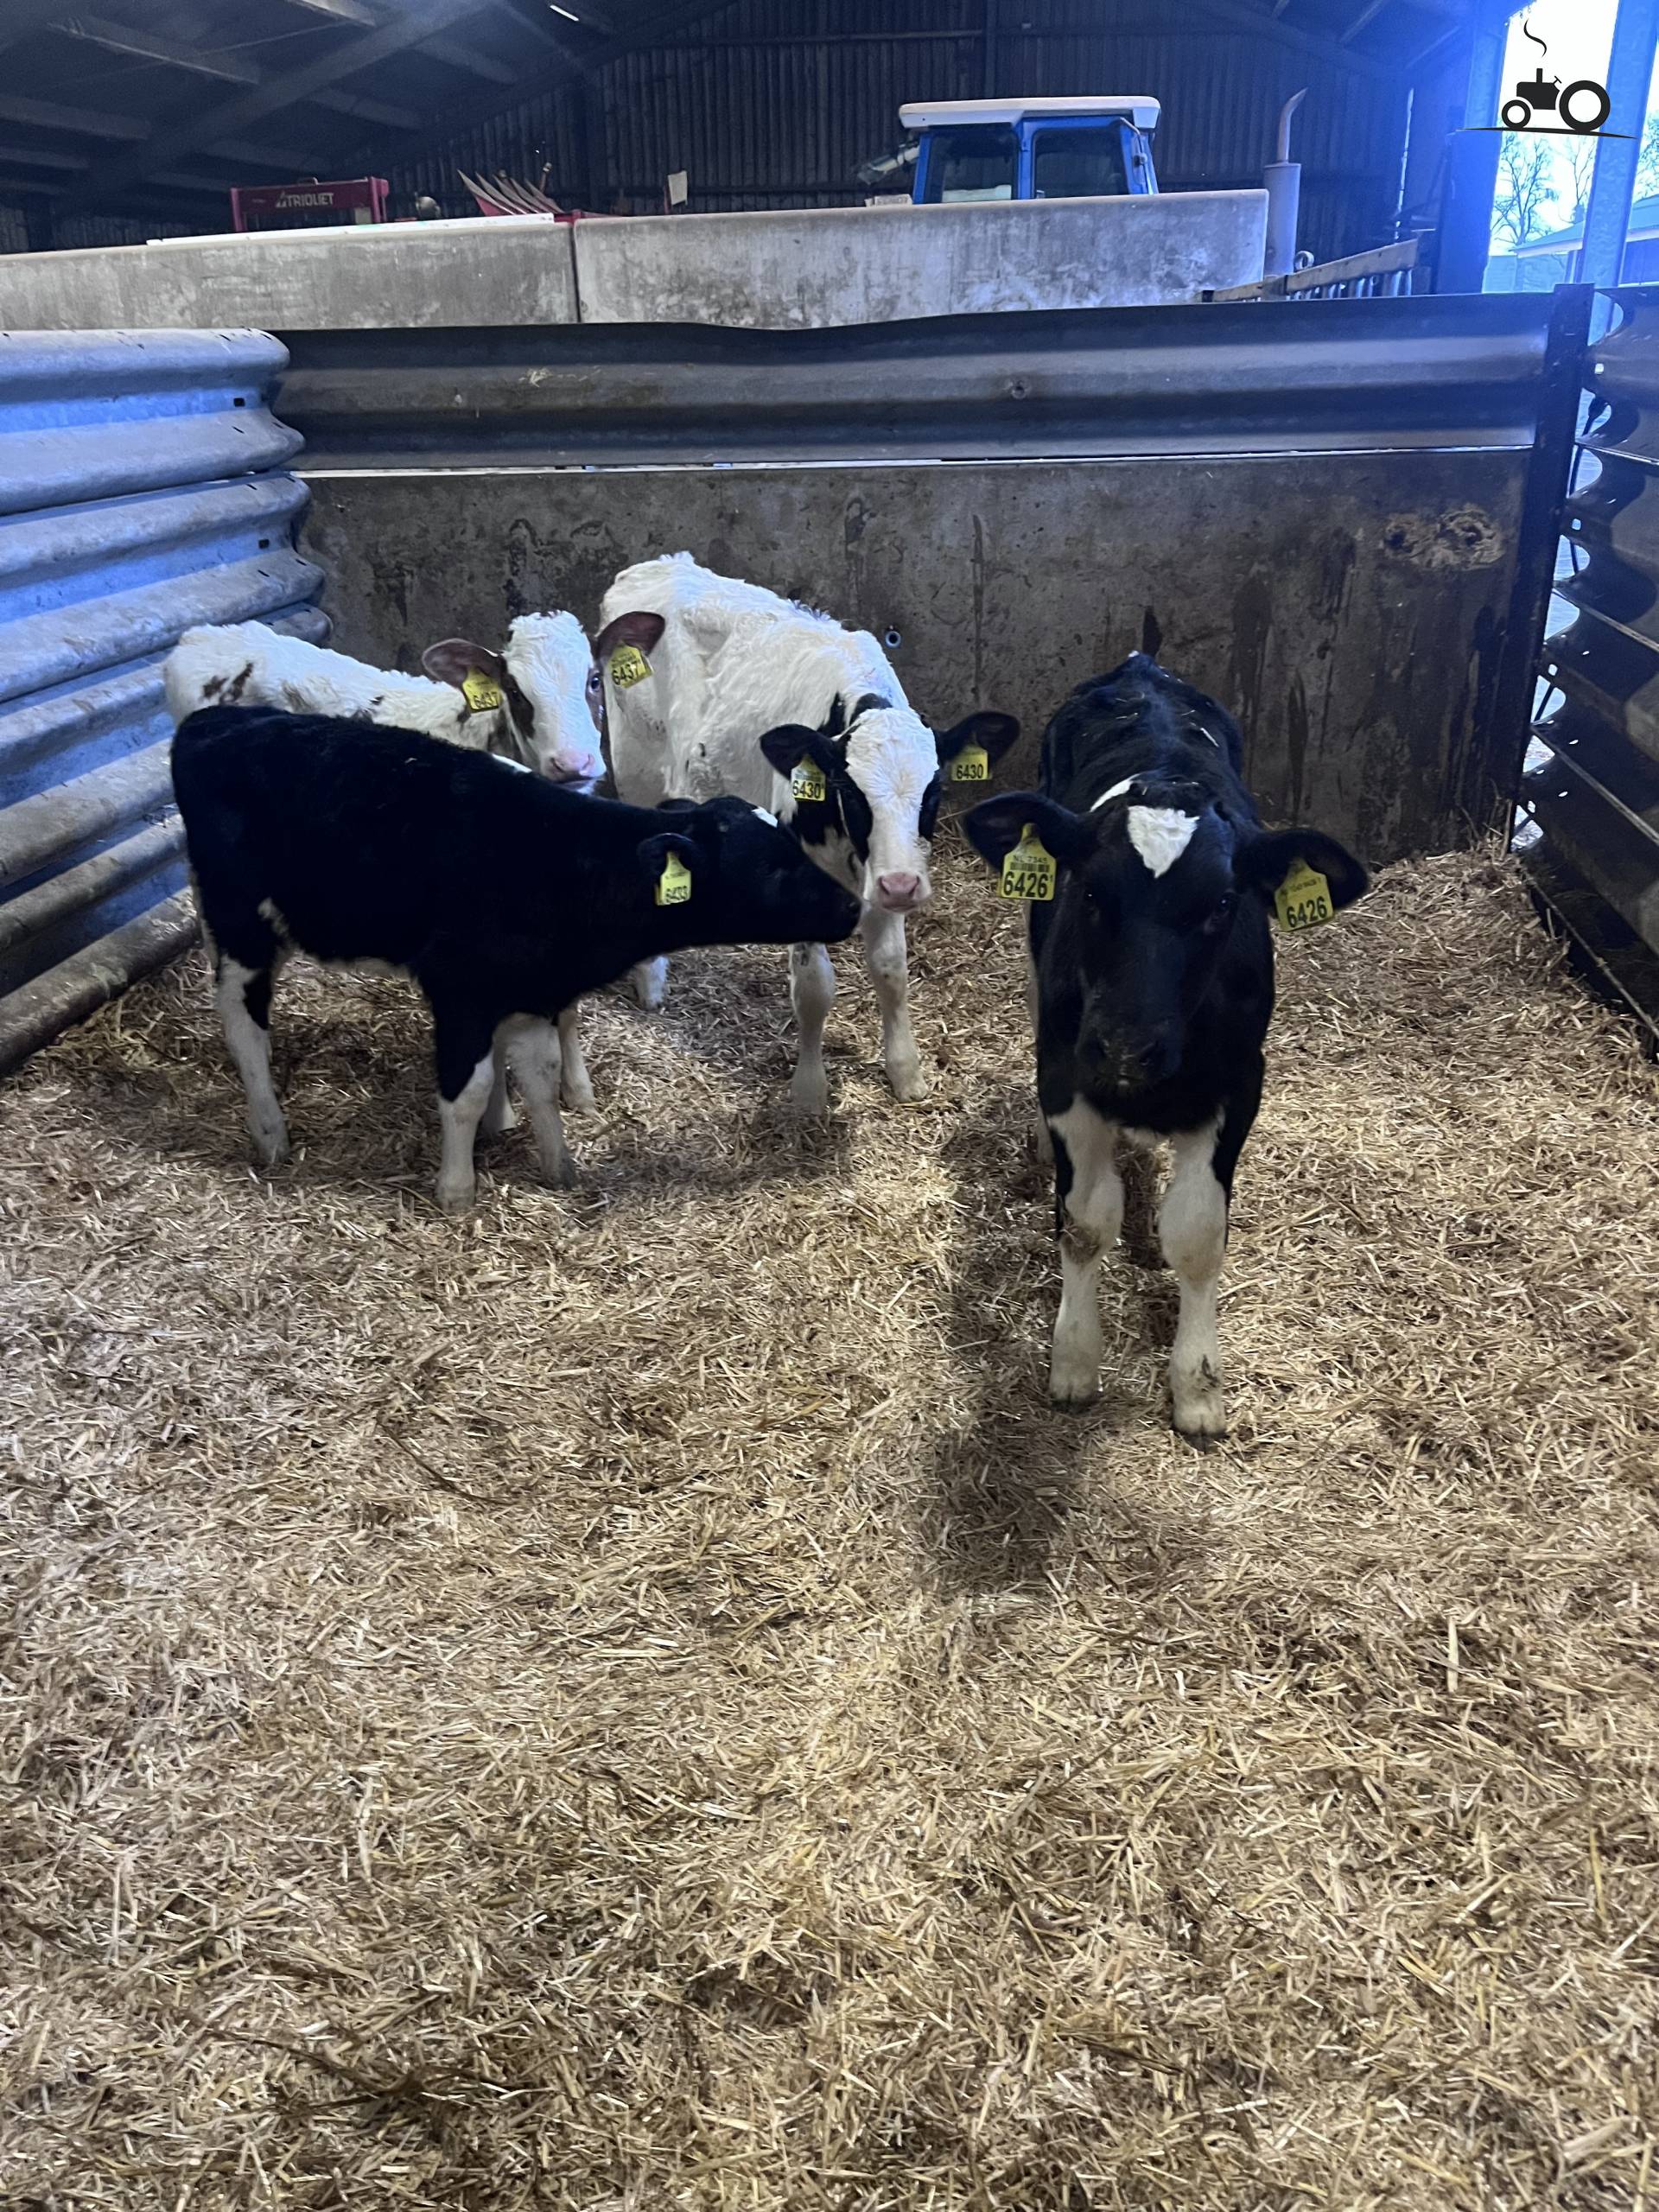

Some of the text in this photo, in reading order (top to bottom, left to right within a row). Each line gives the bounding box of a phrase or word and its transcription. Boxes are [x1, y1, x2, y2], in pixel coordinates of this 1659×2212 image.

[288, 193, 334, 206] TRIOLIET
[957, 763, 983, 779] 6430
[792, 780, 822, 799] 6430
[1003, 871, 1048, 899] 6426
[1287, 895, 1328, 928] 6426
